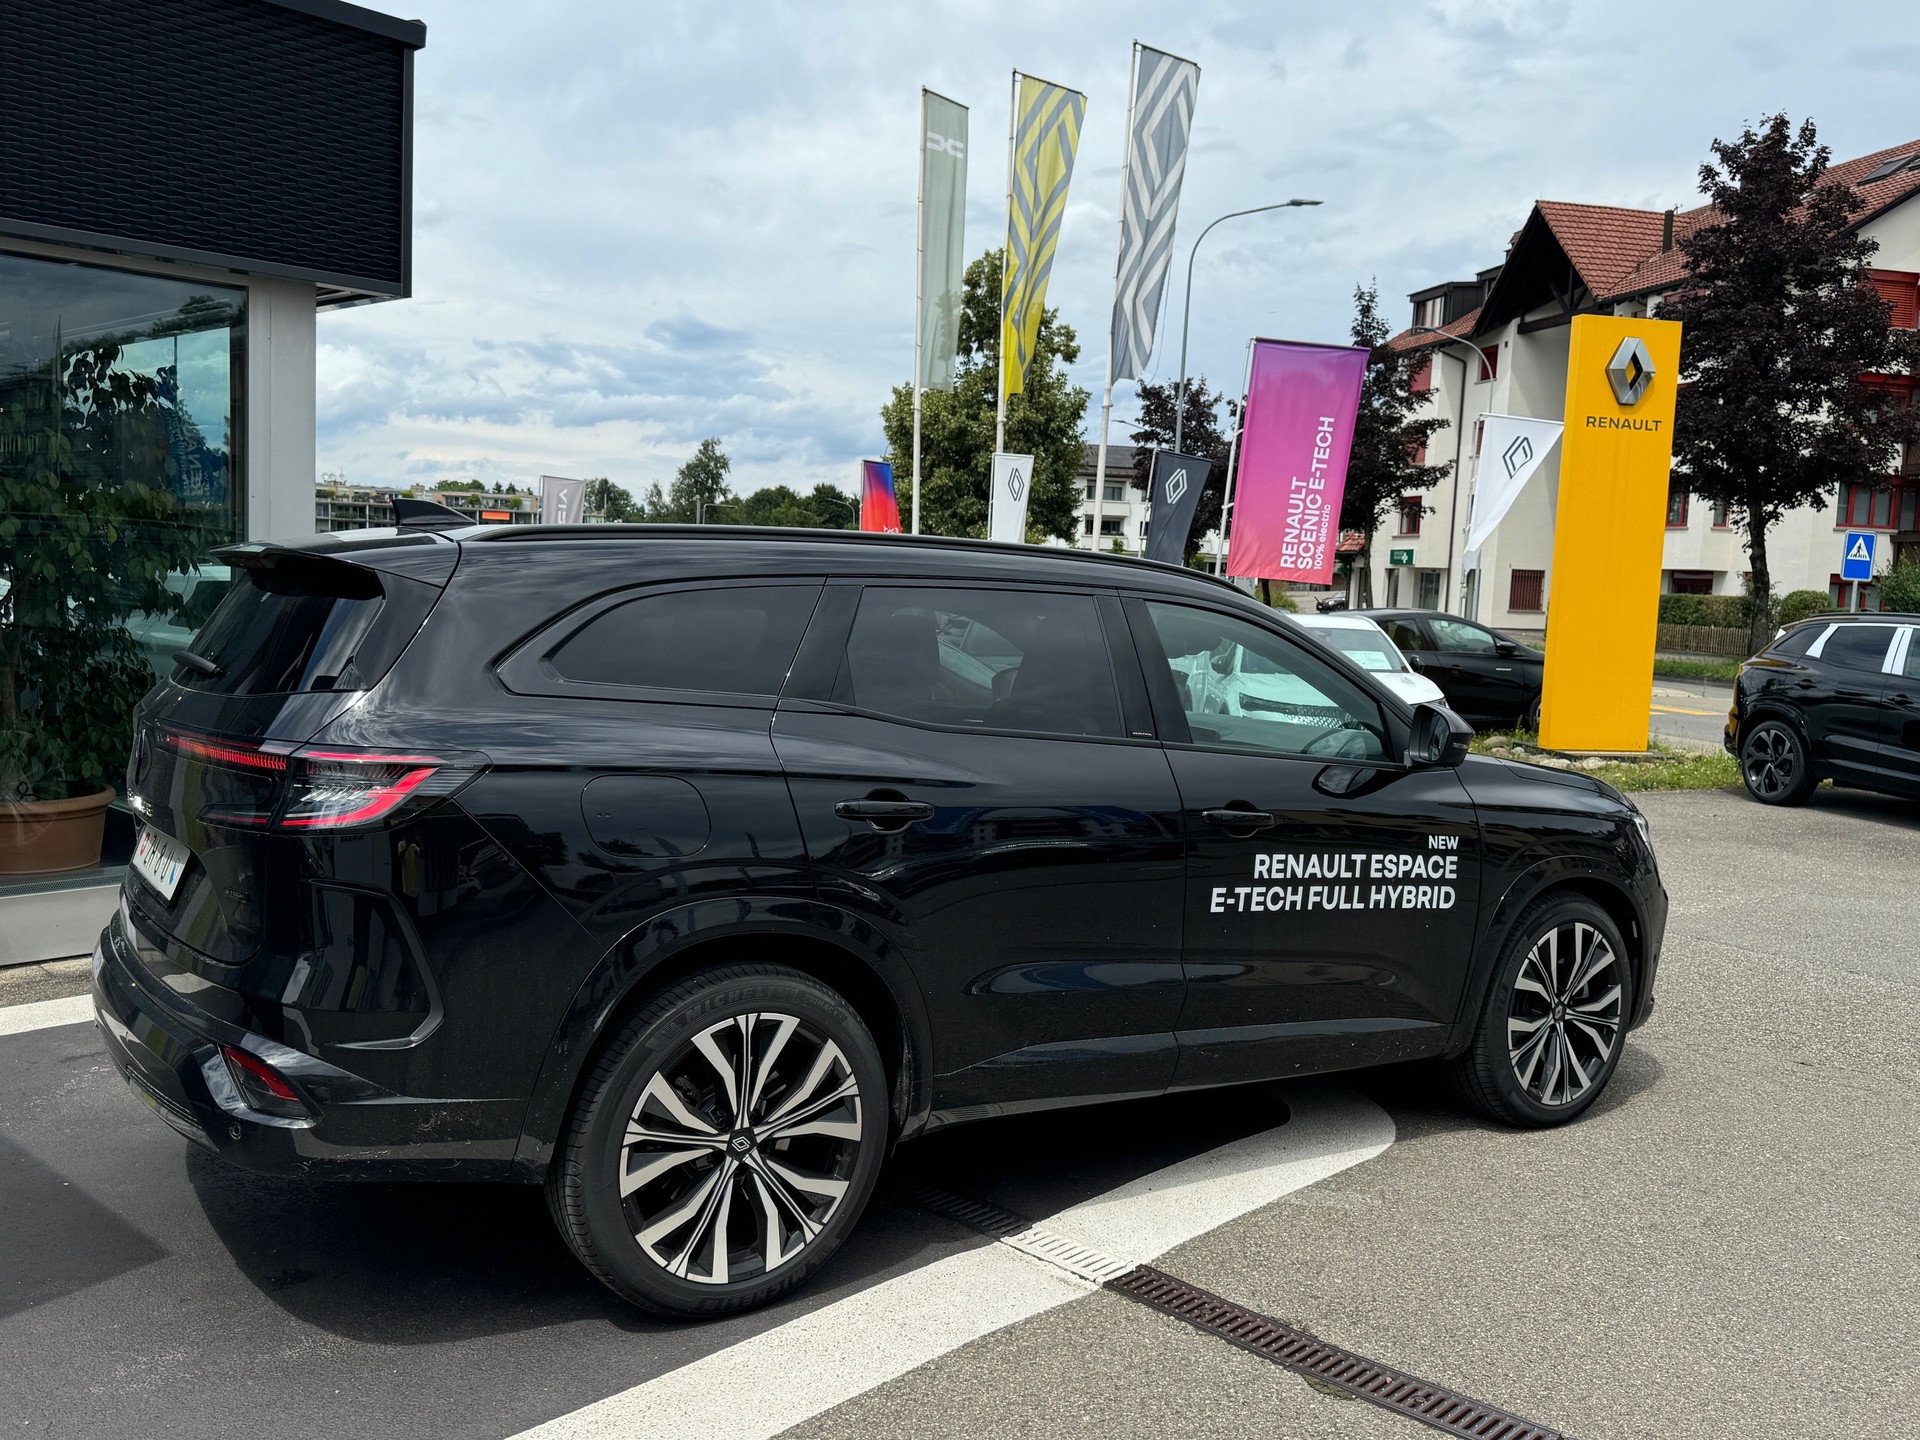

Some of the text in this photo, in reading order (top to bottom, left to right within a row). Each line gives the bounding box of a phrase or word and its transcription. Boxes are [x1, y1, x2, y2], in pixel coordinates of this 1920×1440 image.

[1586, 416, 1662, 431] RENAULT
[1297, 416, 1335, 570] SCENIC E-TECH
[1280, 476, 1307, 568] RENAULT
[1314, 504, 1331, 570] 100% electric
[1428, 835, 1459, 849] NEW
[1253, 854, 1458, 879] RENAULT ESPACE
[1210, 885, 1456, 913] E-TECH FULL HYBRID
[685, 983, 794, 1024] MICHELIN
